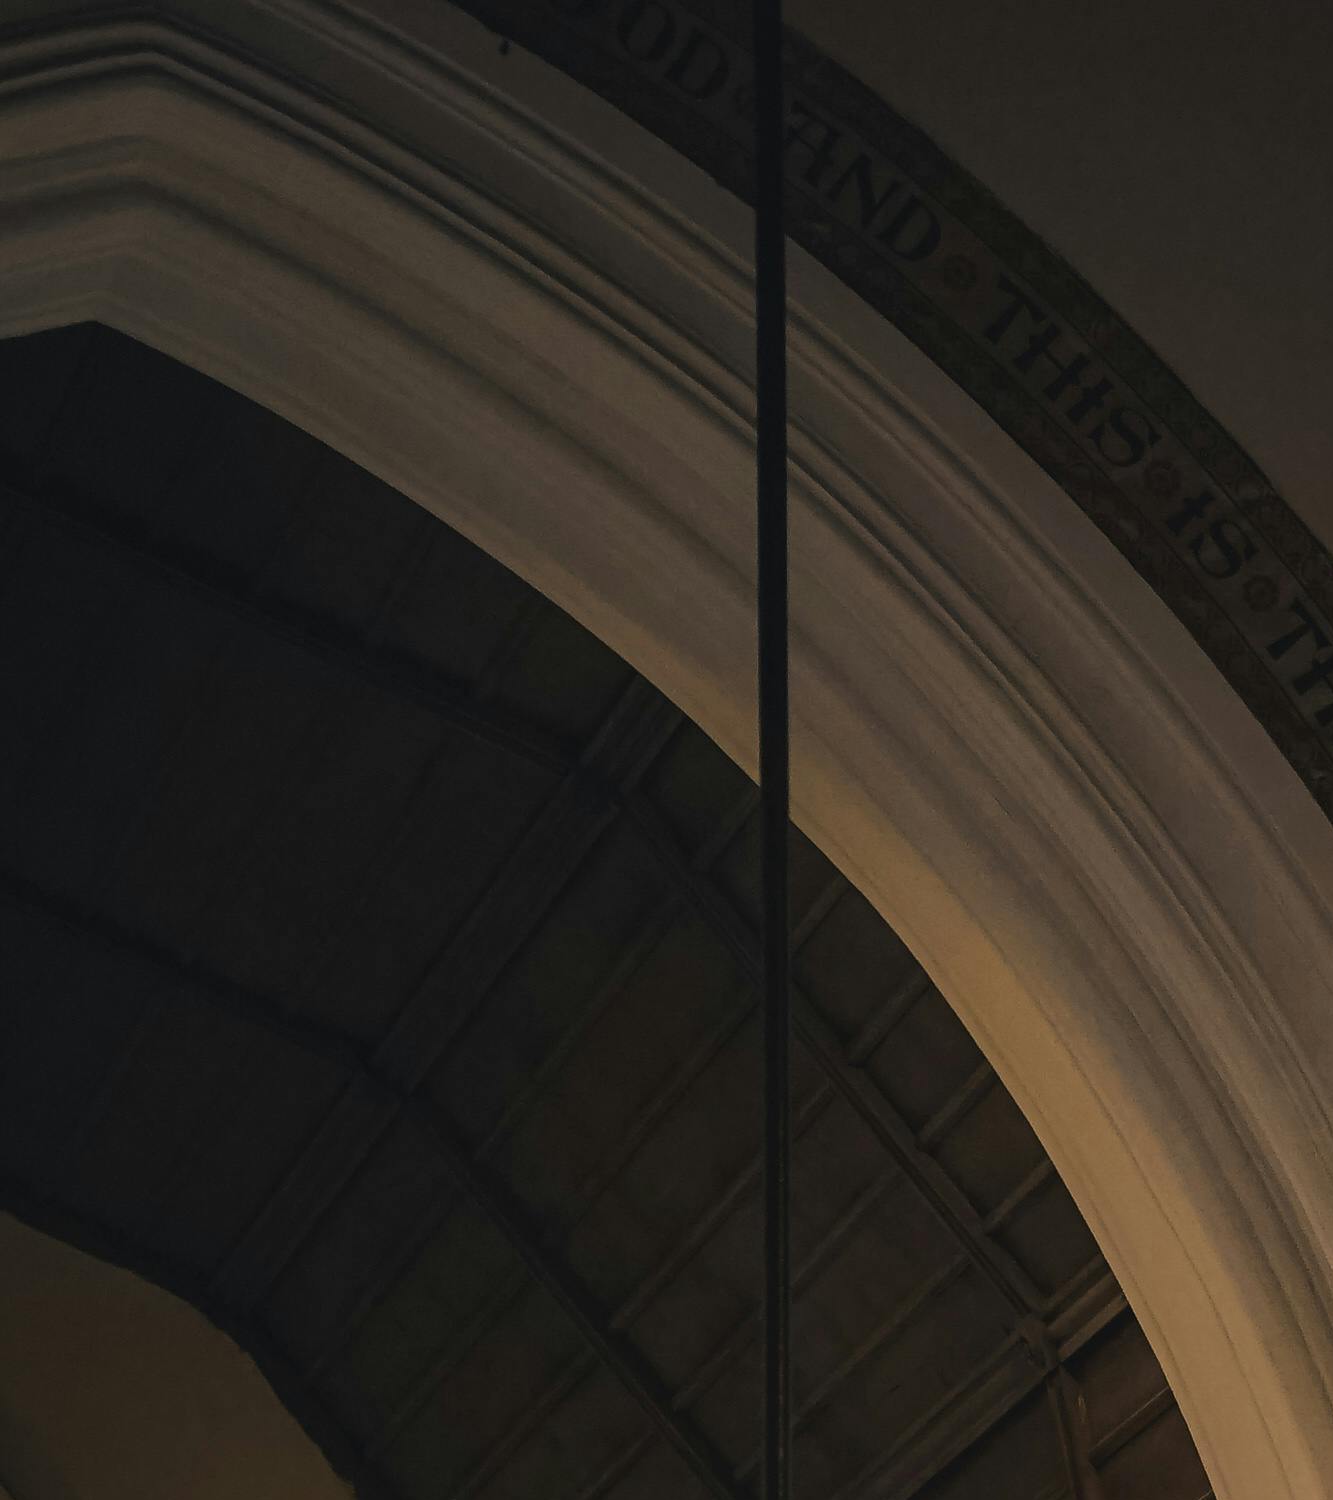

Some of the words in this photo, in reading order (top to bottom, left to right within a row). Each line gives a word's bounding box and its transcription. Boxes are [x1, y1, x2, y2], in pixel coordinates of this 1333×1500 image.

[555, 0, 729, 100] OD
[782, 101, 941, 260] AND
[986, 277, 1161, 467] THIS
[1166, 494, 1260, 579] IS
